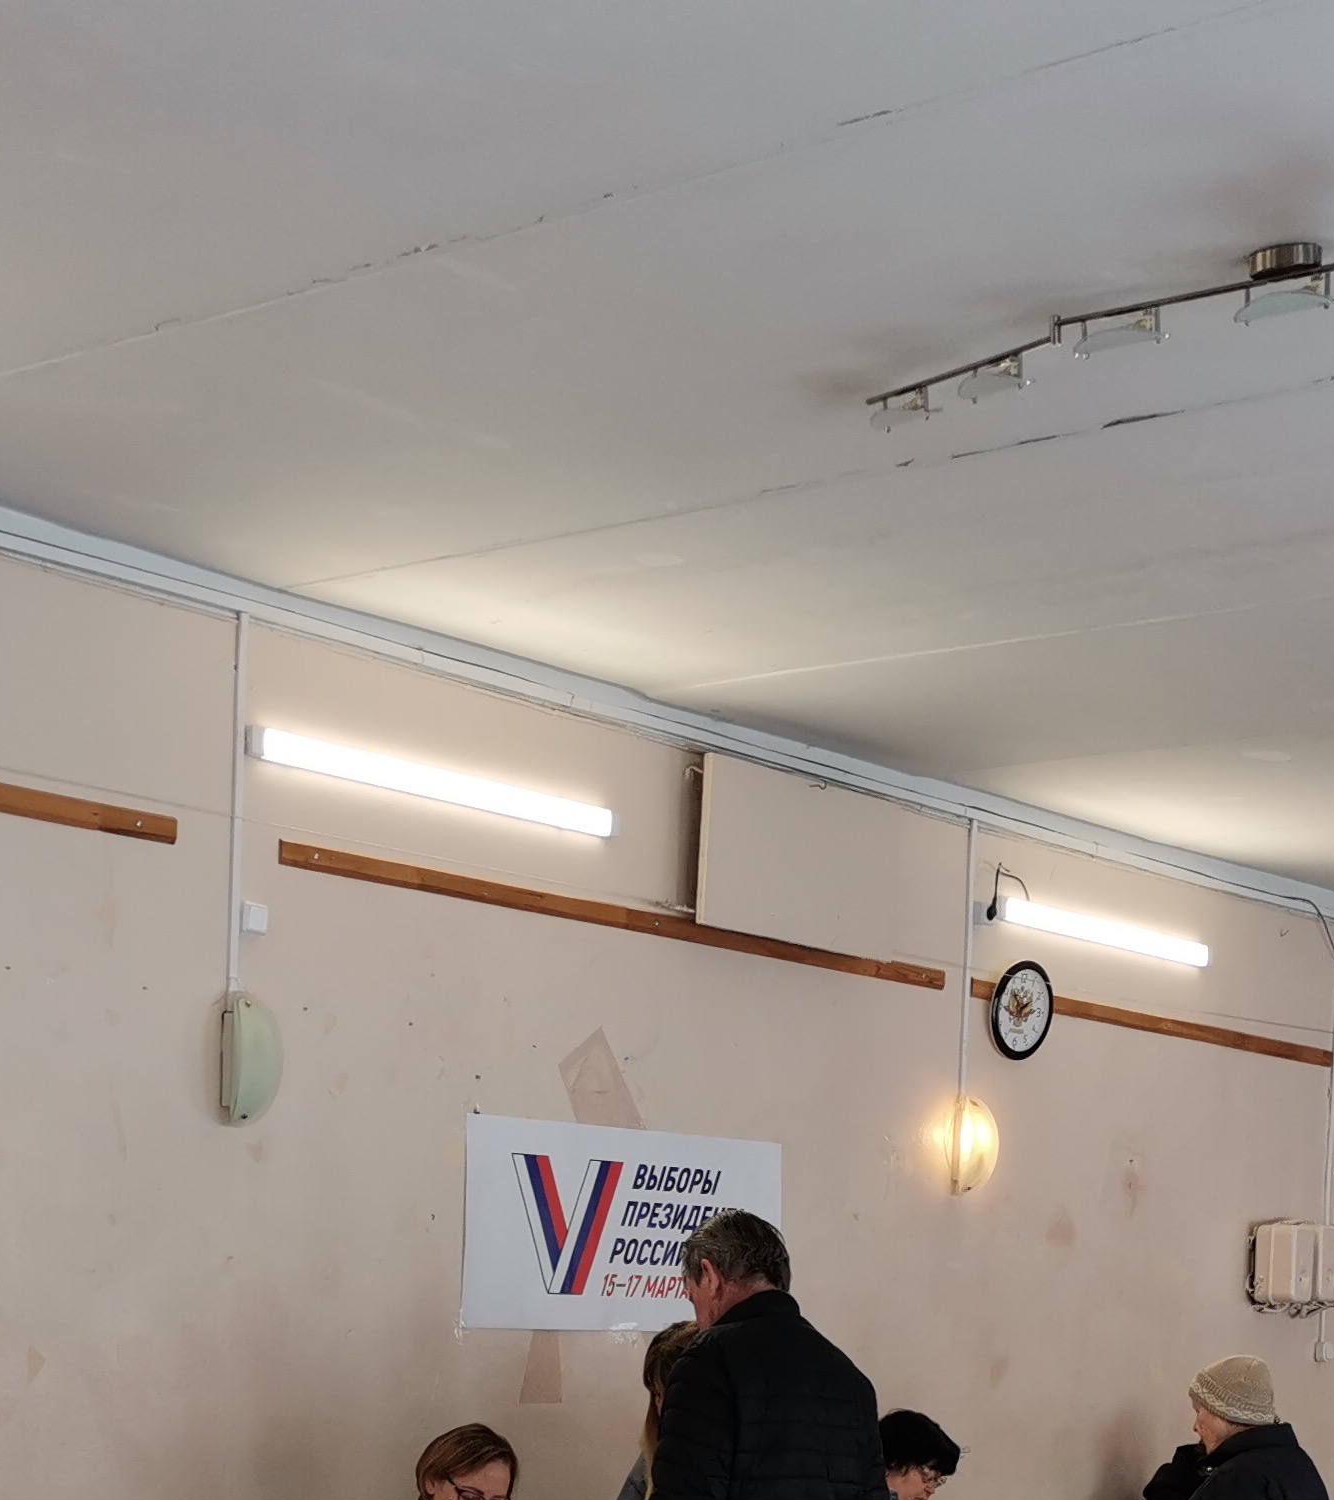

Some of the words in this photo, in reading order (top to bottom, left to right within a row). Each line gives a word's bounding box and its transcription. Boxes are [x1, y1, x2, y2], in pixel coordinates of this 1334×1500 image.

[632, 1163, 722, 1196] ВЫБОРЫ
[620, 1200, 744, 1234] ПРЕЗИДЕ
[609, 1237, 687, 1267] РОССИ
